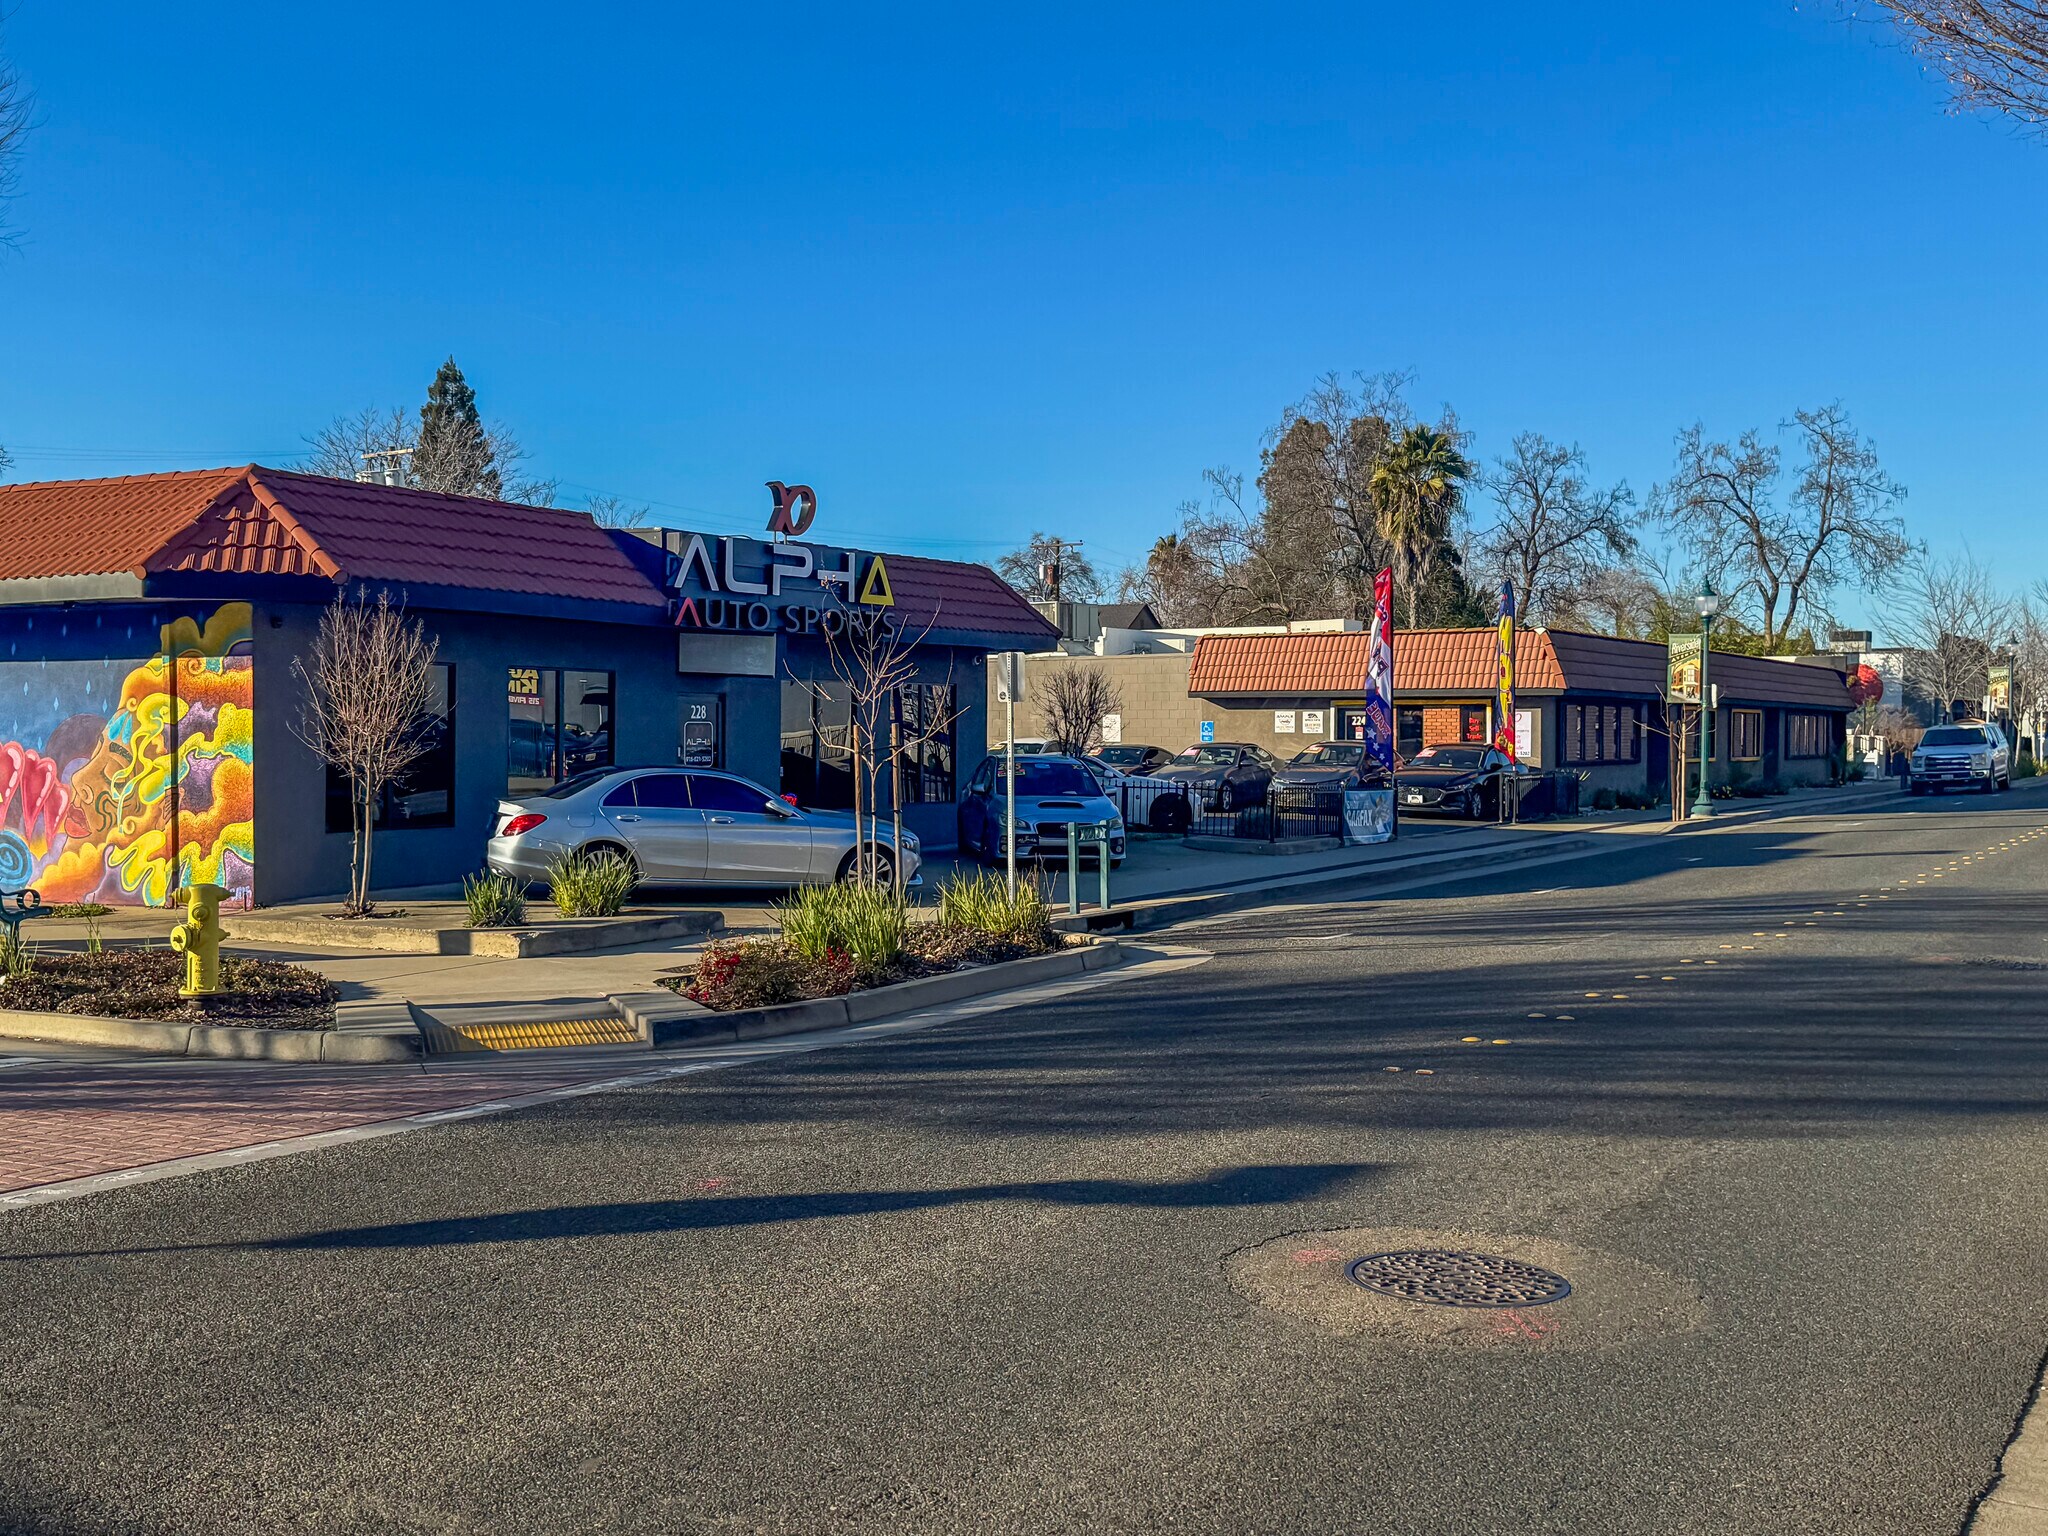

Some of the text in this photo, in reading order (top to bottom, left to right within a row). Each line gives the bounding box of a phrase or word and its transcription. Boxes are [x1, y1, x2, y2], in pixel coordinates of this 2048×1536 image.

[674, 534, 895, 606] ALPHA
[674, 597, 896, 639] AUTO SPORTS
[1671, 639, 1701, 655] Riverside
[690, 704, 707, 719] 228
[1351, 716, 1366, 726] 224
[1468, 717, 1480, 725] Buy
[686, 738, 712, 746] ALPHA
[1346, 809, 1373, 827] CARFAX
